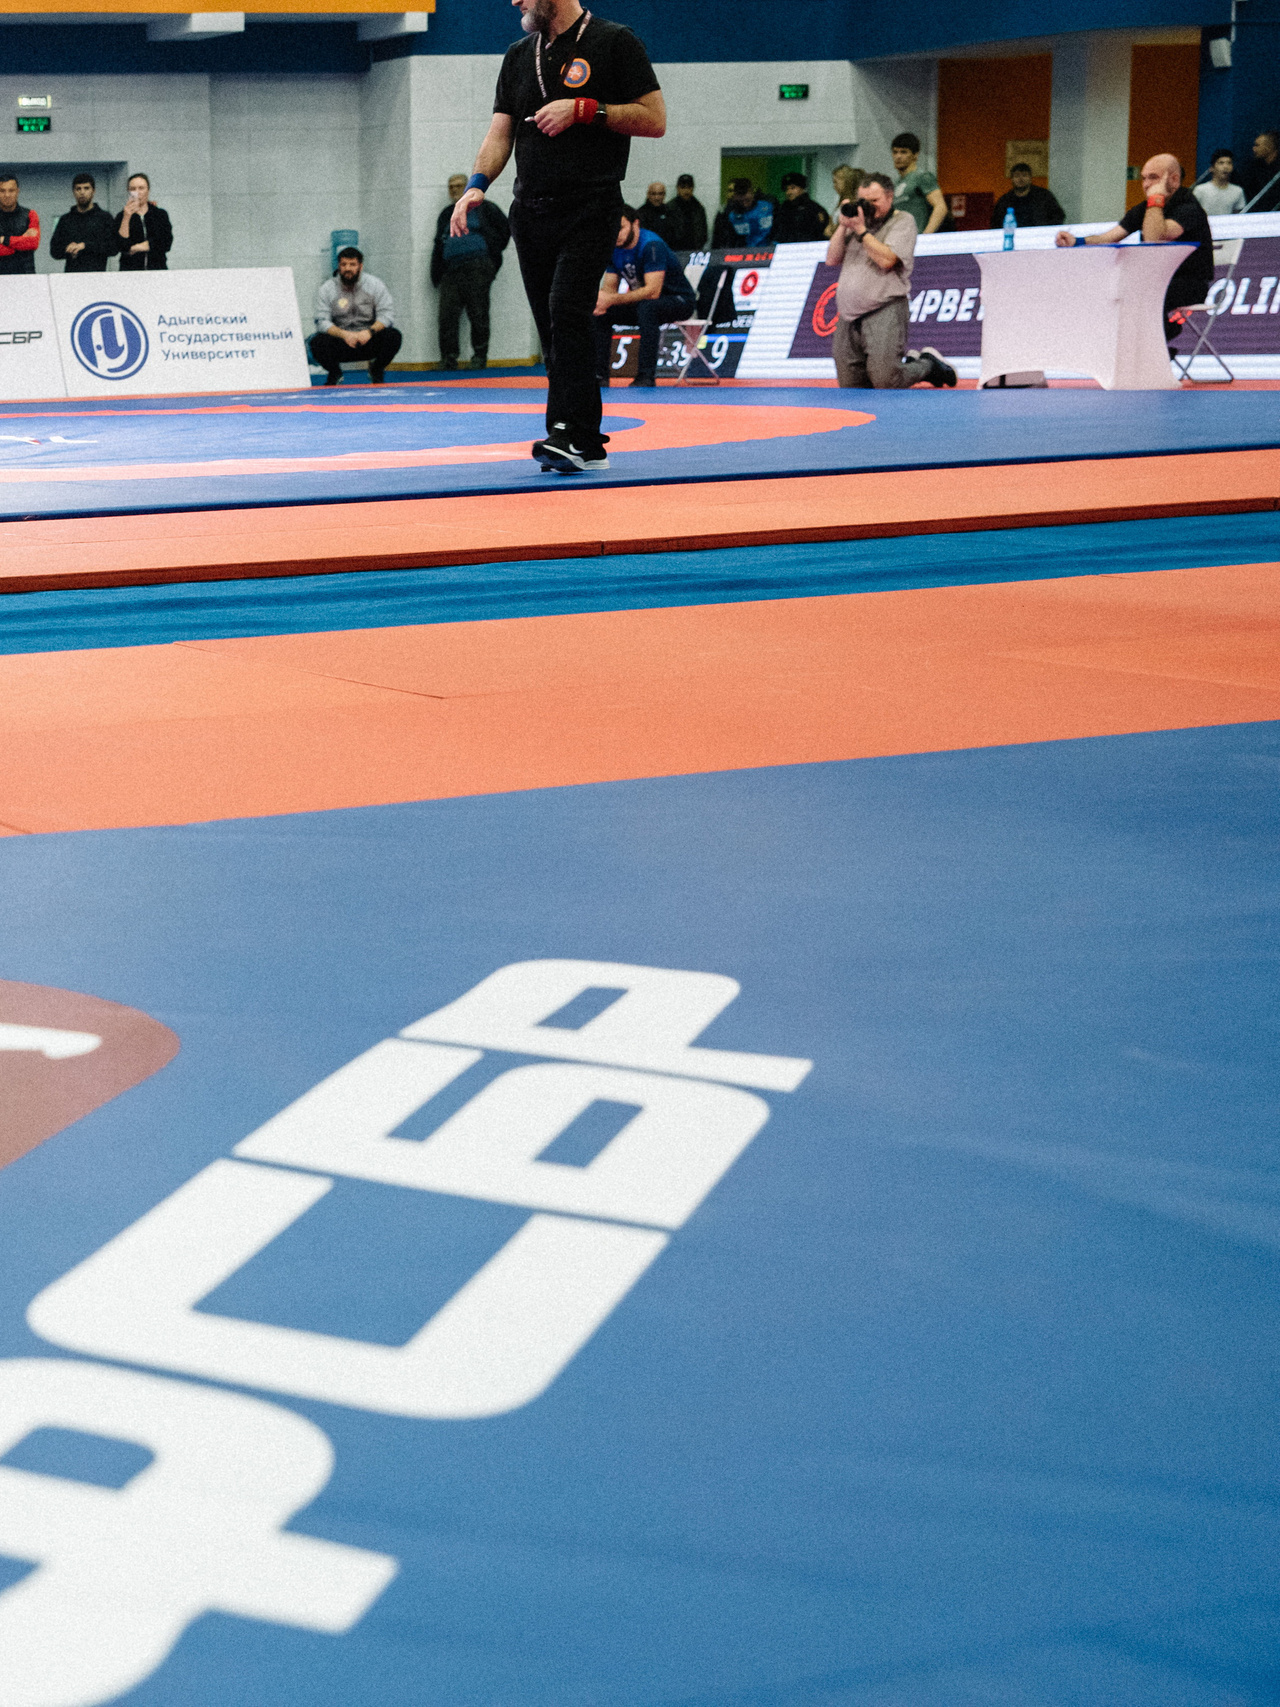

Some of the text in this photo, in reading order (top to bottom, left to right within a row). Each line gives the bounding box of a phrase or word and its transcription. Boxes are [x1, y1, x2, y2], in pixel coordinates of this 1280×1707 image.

[907, 287, 986, 322] MPBE
[1204, 276, 1280, 316] OLI
[157, 314, 248, 327] Адыгейский
[159, 328, 294, 345] Государственный
[160, 348, 256, 363] Университет
[611, 336, 633, 370] 5
[708, 335, 730, 370] 9
